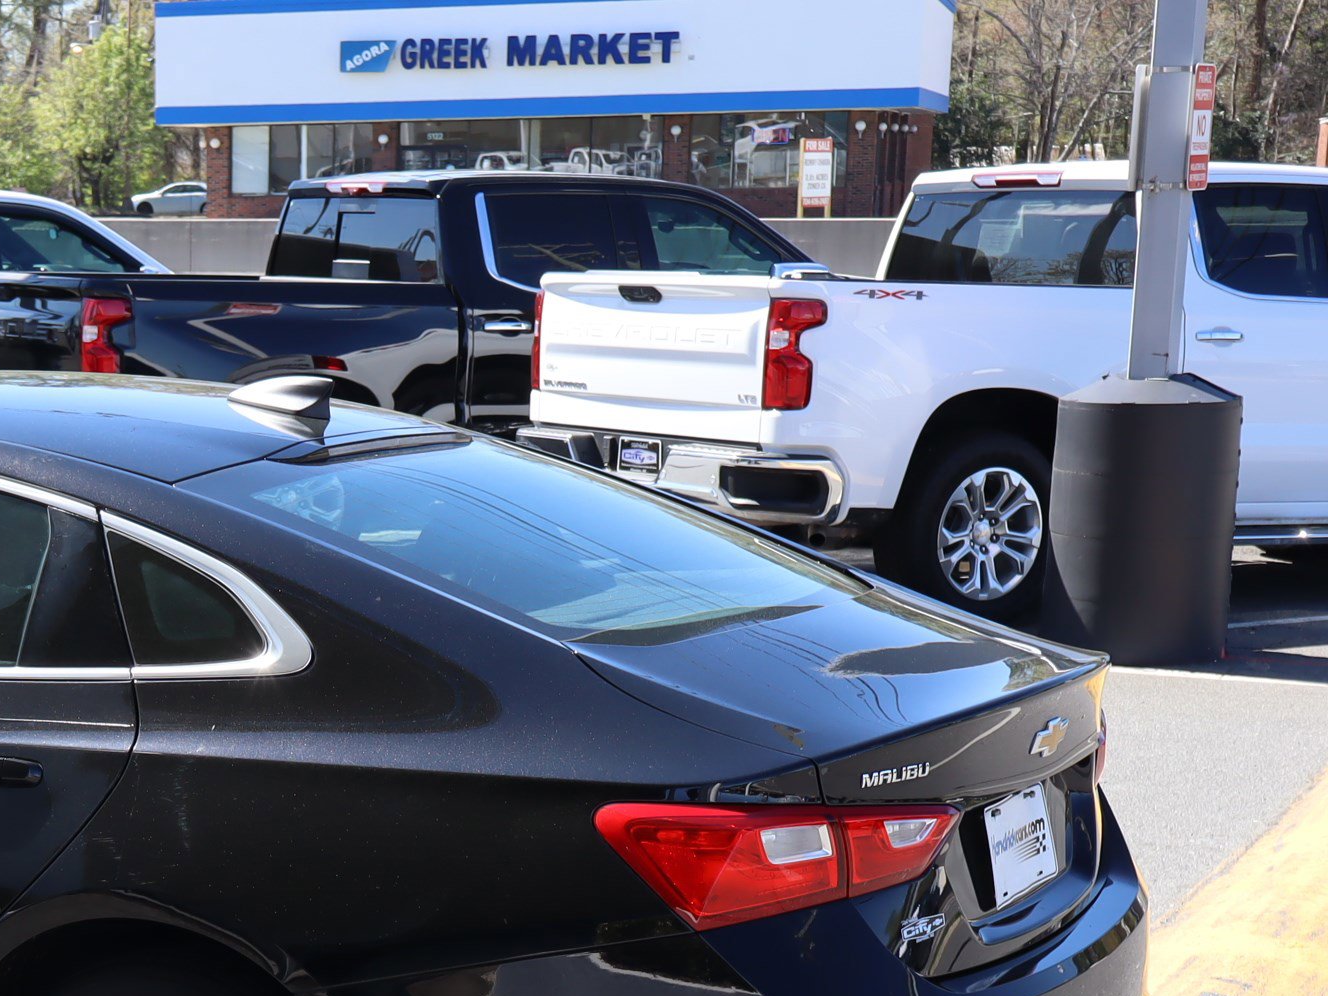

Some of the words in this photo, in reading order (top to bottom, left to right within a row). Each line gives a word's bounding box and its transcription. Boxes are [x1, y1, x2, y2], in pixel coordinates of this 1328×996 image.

[345, 41, 390, 72] AGORA
[400, 37, 488, 70] GREEK
[506, 31, 680, 67] MARKET
[1197, 114, 1207, 137] NO
[806, 140, 817, 150] FOR
[818, 140, 830, 150] SALE
[623, 450, 646, 463] City
[861, 762, 930, 788] MALIBU
